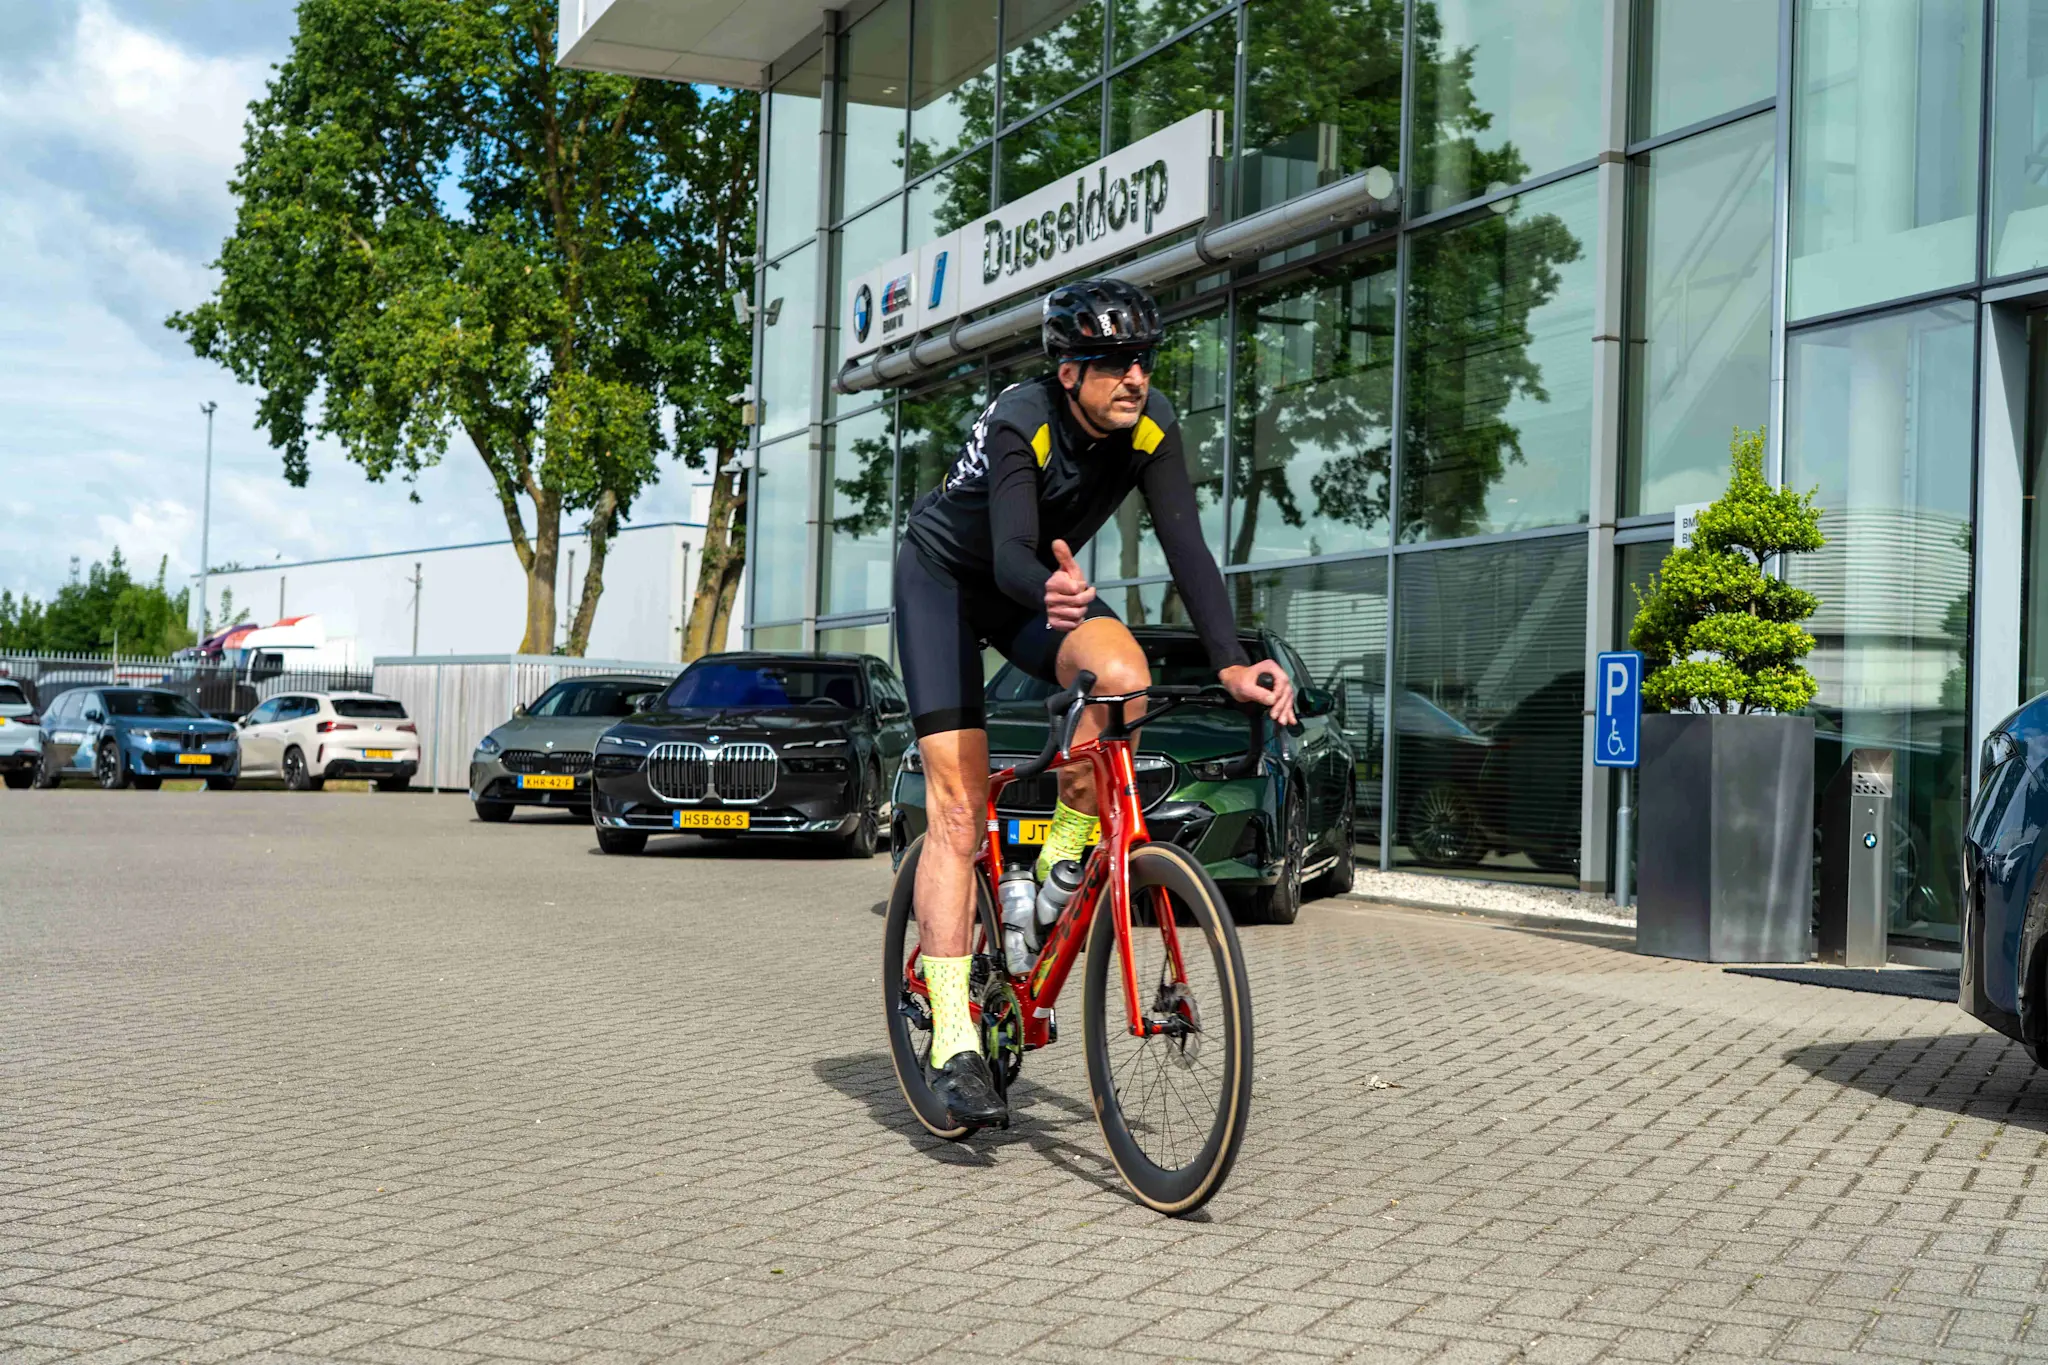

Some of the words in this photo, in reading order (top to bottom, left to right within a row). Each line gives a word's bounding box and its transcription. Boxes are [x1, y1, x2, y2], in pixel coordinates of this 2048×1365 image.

[983, 159, 1168, 285] Dusseldorp
[1606, 662, 1629, 717] P
[526, 778, 571, 788] KHR-42-F
[684, 813, 744, 826] HSB-68-S
